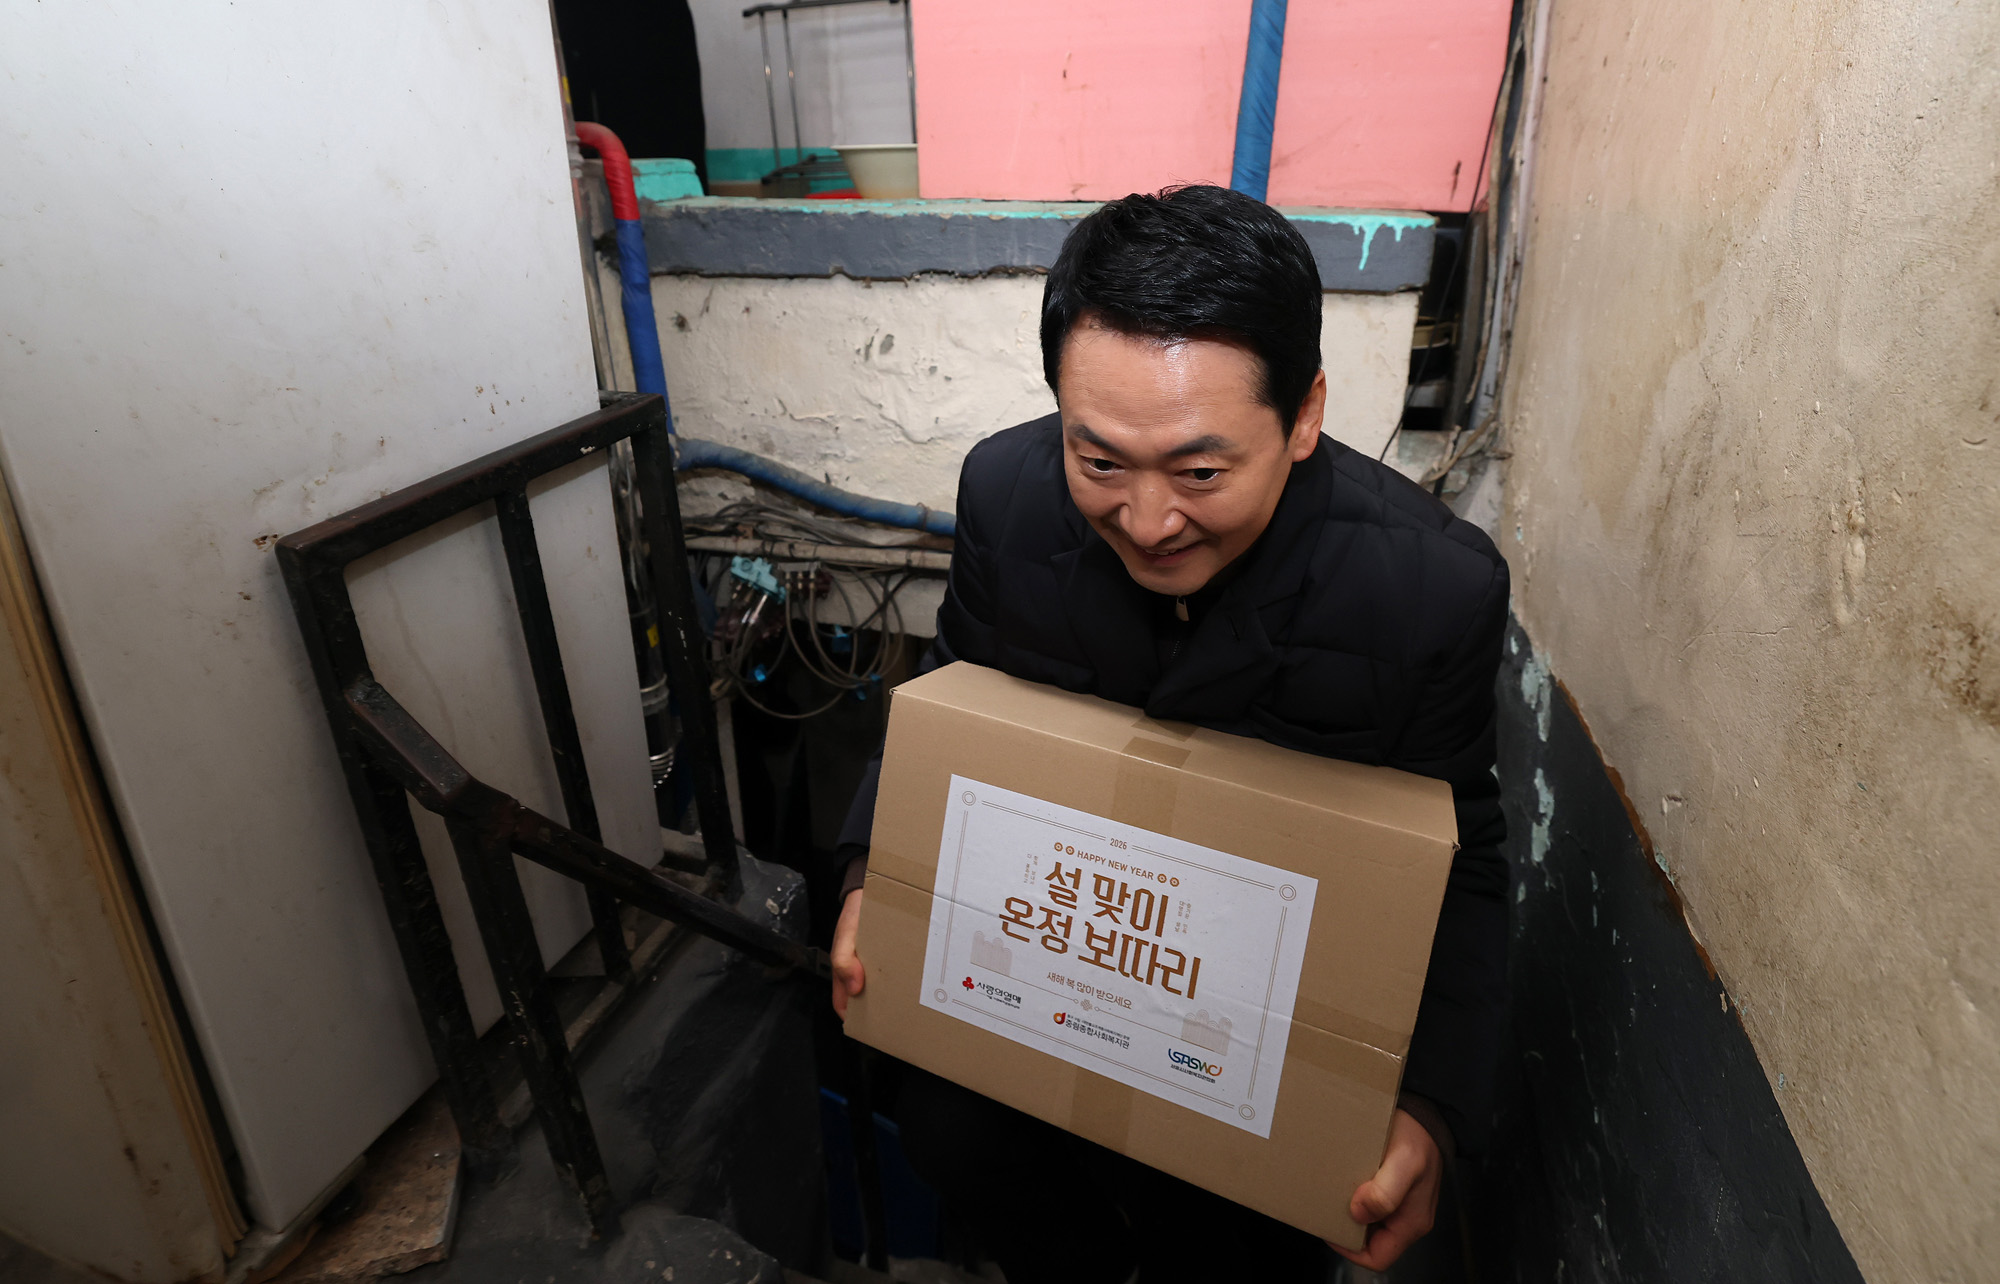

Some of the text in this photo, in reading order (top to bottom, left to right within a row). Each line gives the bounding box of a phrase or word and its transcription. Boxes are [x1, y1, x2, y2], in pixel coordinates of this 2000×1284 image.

[1110, 838, 1127, 850] 2026
[1077, 850, 1154, 880] HAPPY NEW YEAR
[1044, 861, 1082, 910] 설
[1093, 873, 1169, 938] 맞이
[999, 896, 1201, 1000] 온정 보따리
[976, 982, 1022, 1004] 사랑의열매
[1047, 972, 1132, 1010] 새해 복 많이 받으세요
